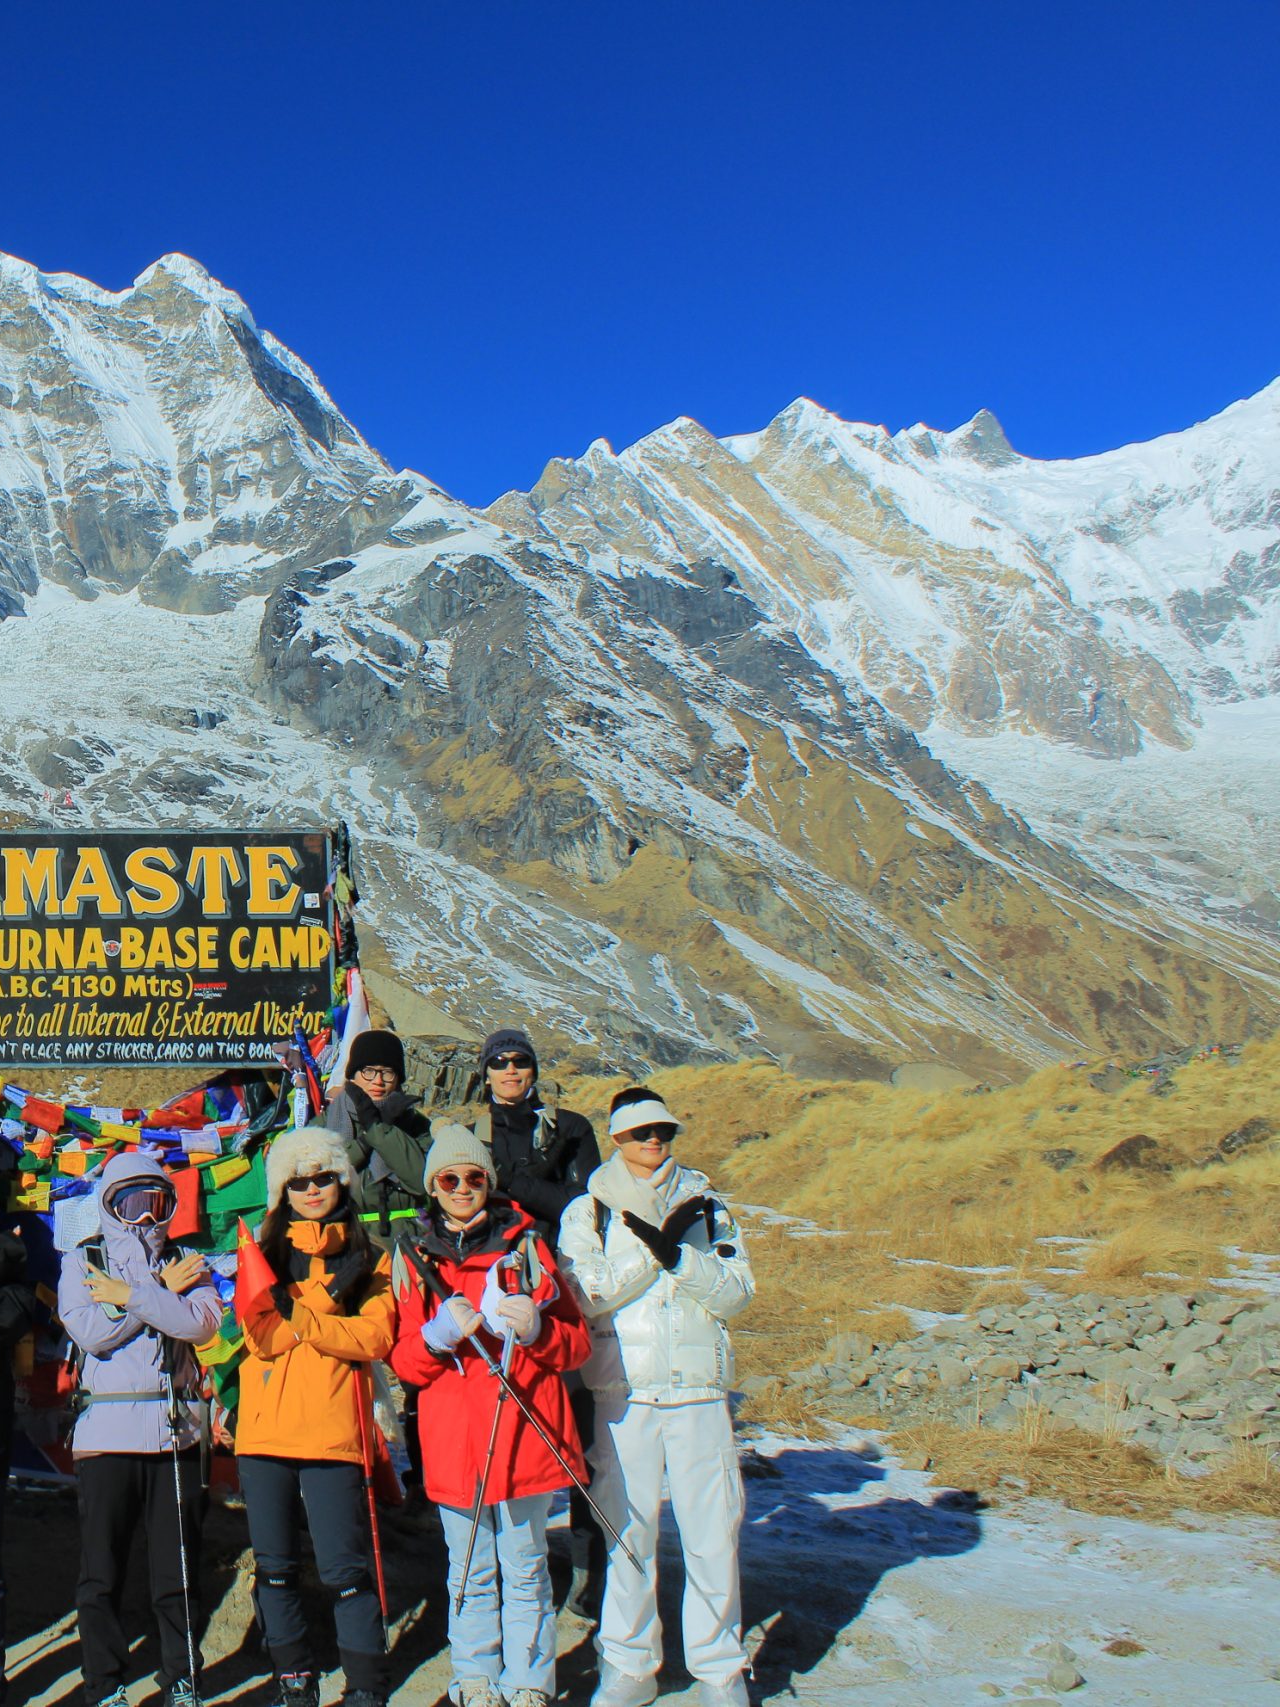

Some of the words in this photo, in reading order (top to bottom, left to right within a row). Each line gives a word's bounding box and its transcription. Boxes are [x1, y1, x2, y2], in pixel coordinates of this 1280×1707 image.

[120, 926, 219, 971] BASE
[230, 926, 331, 970] CAMP
[123, 972, 194, 1000] Mtrs)
[15, 1002, 35, 1037] to
[36, 1002, 67, 1037] all
[67, 1001, 152, 1037] Internal
[22, 1042, 62, 1062] PLACE
[65, 1042, 94, 1059] ANY
[197, 1042, 214, 1059] ON
[216, 1042, 245, 1059] THIS
[248, 1042, 278, 1059] BOA
